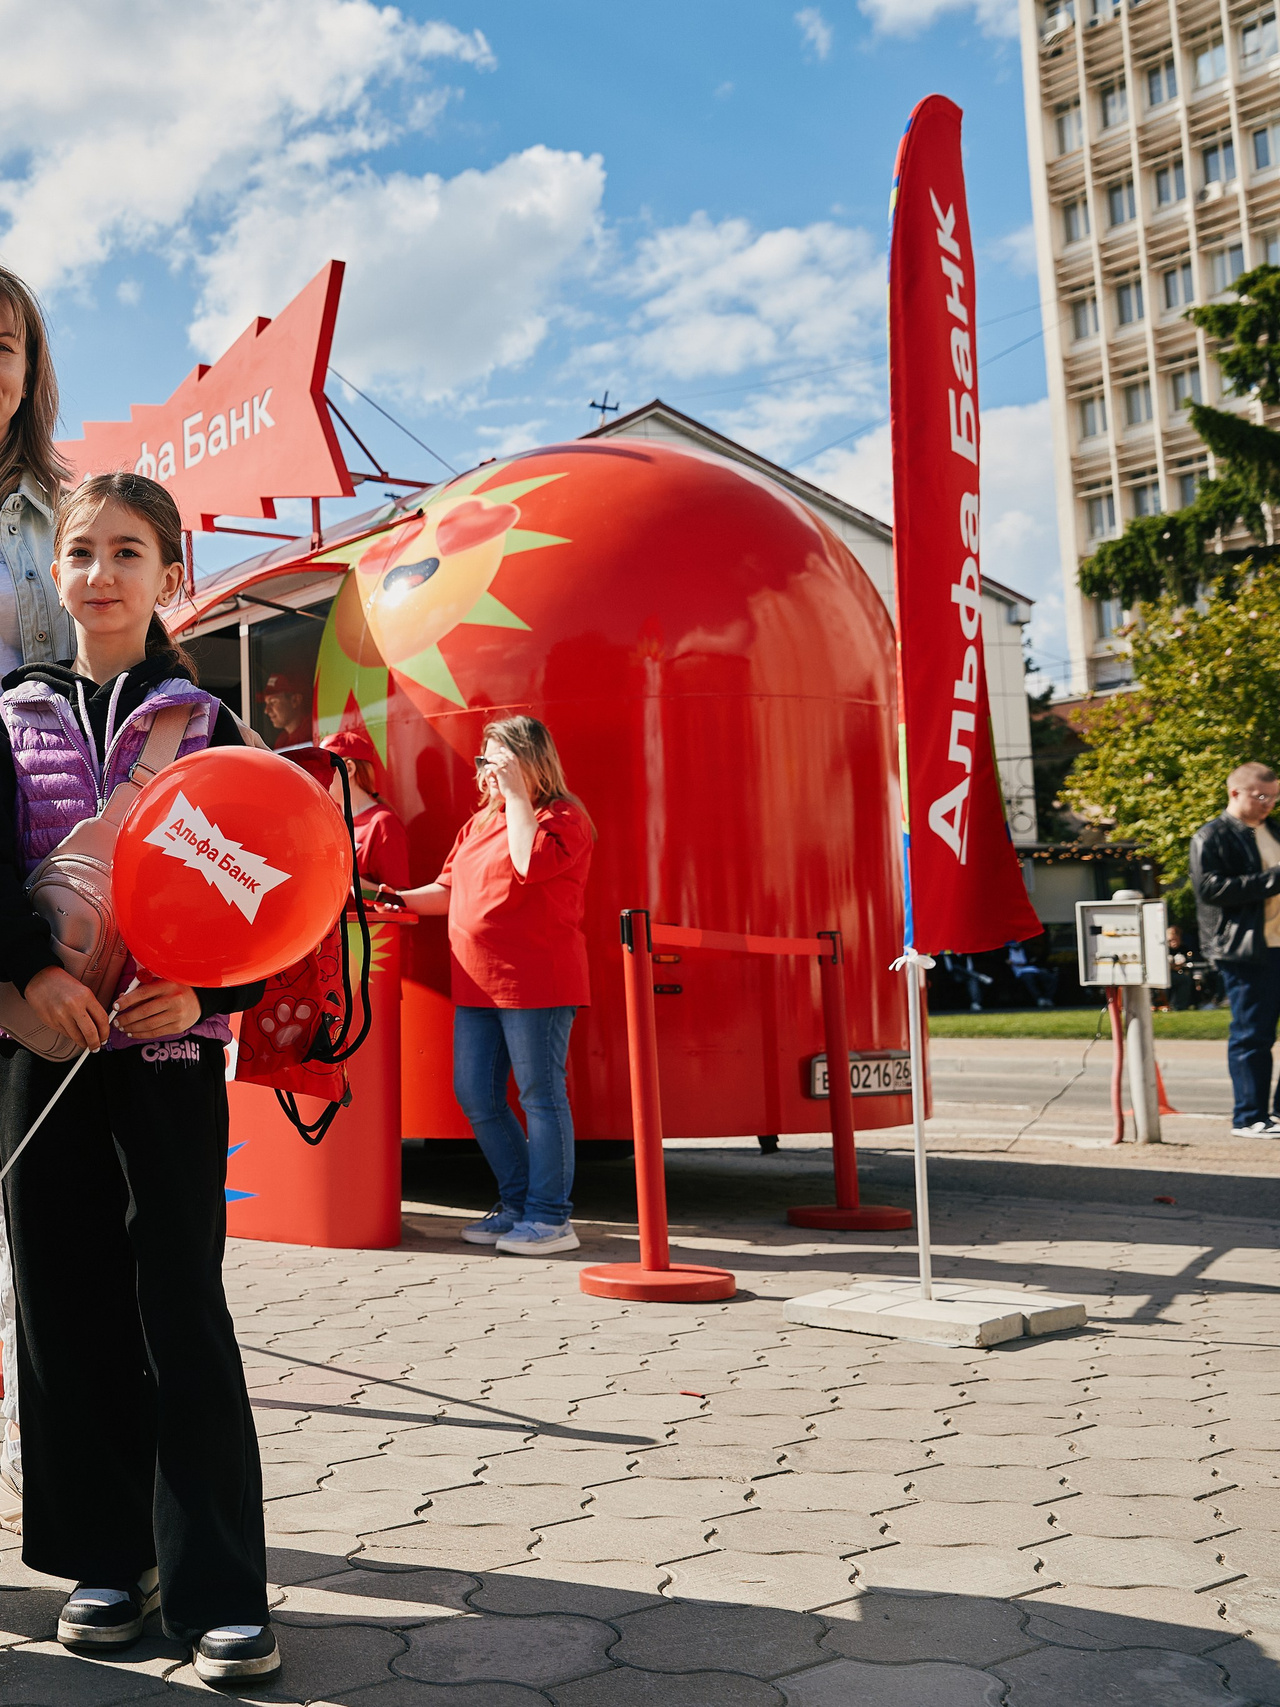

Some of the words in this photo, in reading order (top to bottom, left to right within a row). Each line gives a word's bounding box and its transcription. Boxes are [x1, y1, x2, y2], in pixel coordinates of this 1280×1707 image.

[929, 187, 979, 467] Банк
[183, 387, 276, 470] Банк
[928, 491, 981, 862] Альфа
[167, 818, 220, 863] Альфа
[217, 853, 262, 894] Банк
